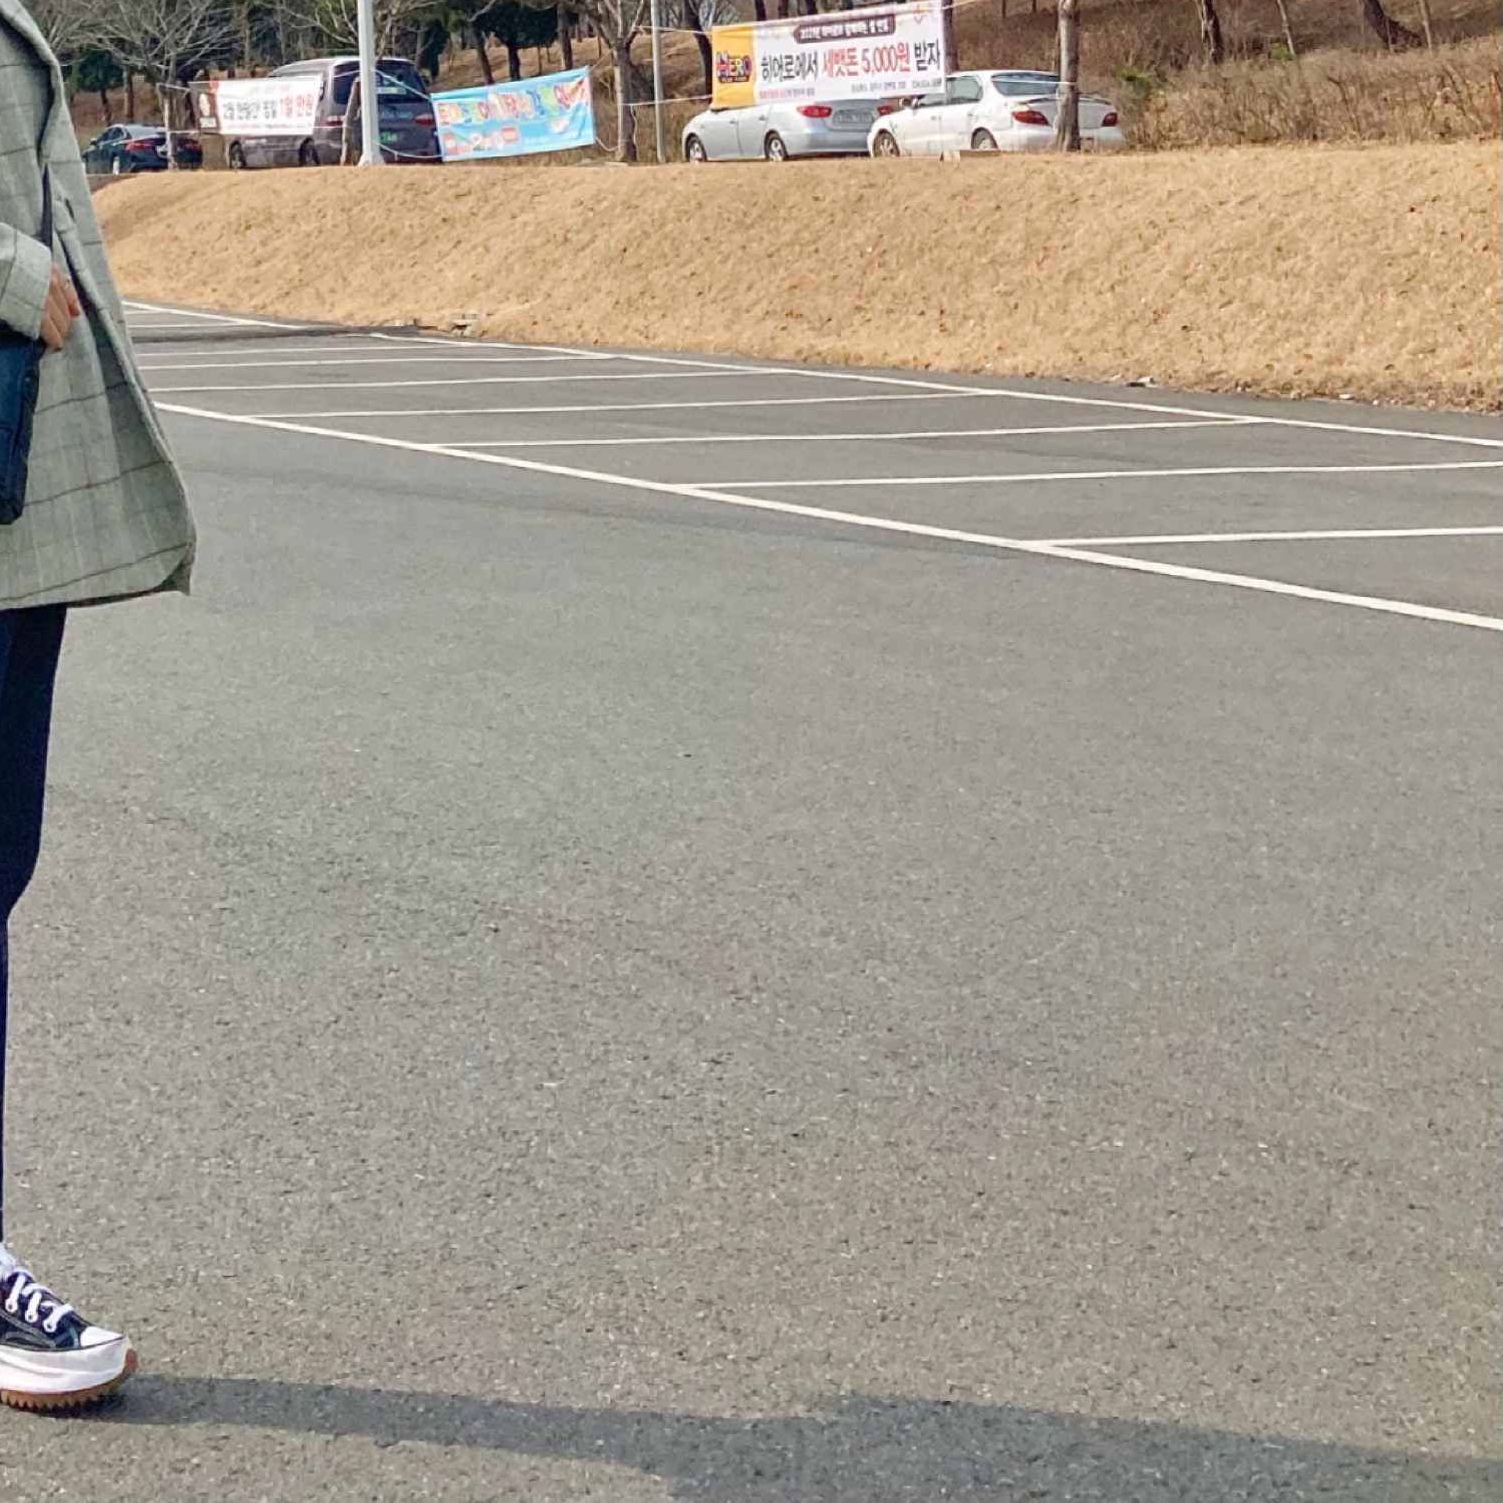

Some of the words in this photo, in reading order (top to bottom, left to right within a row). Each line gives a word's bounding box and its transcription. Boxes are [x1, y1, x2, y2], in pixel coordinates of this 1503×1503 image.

[716, 50, 752, 79] HERO
[761, 51, 818, 83] 히어로에서
[823, 47, 859, 78] 세뱃돈
[861, 41, 911, 76] 5,000원
[913, 38, 941, 72] 받자
